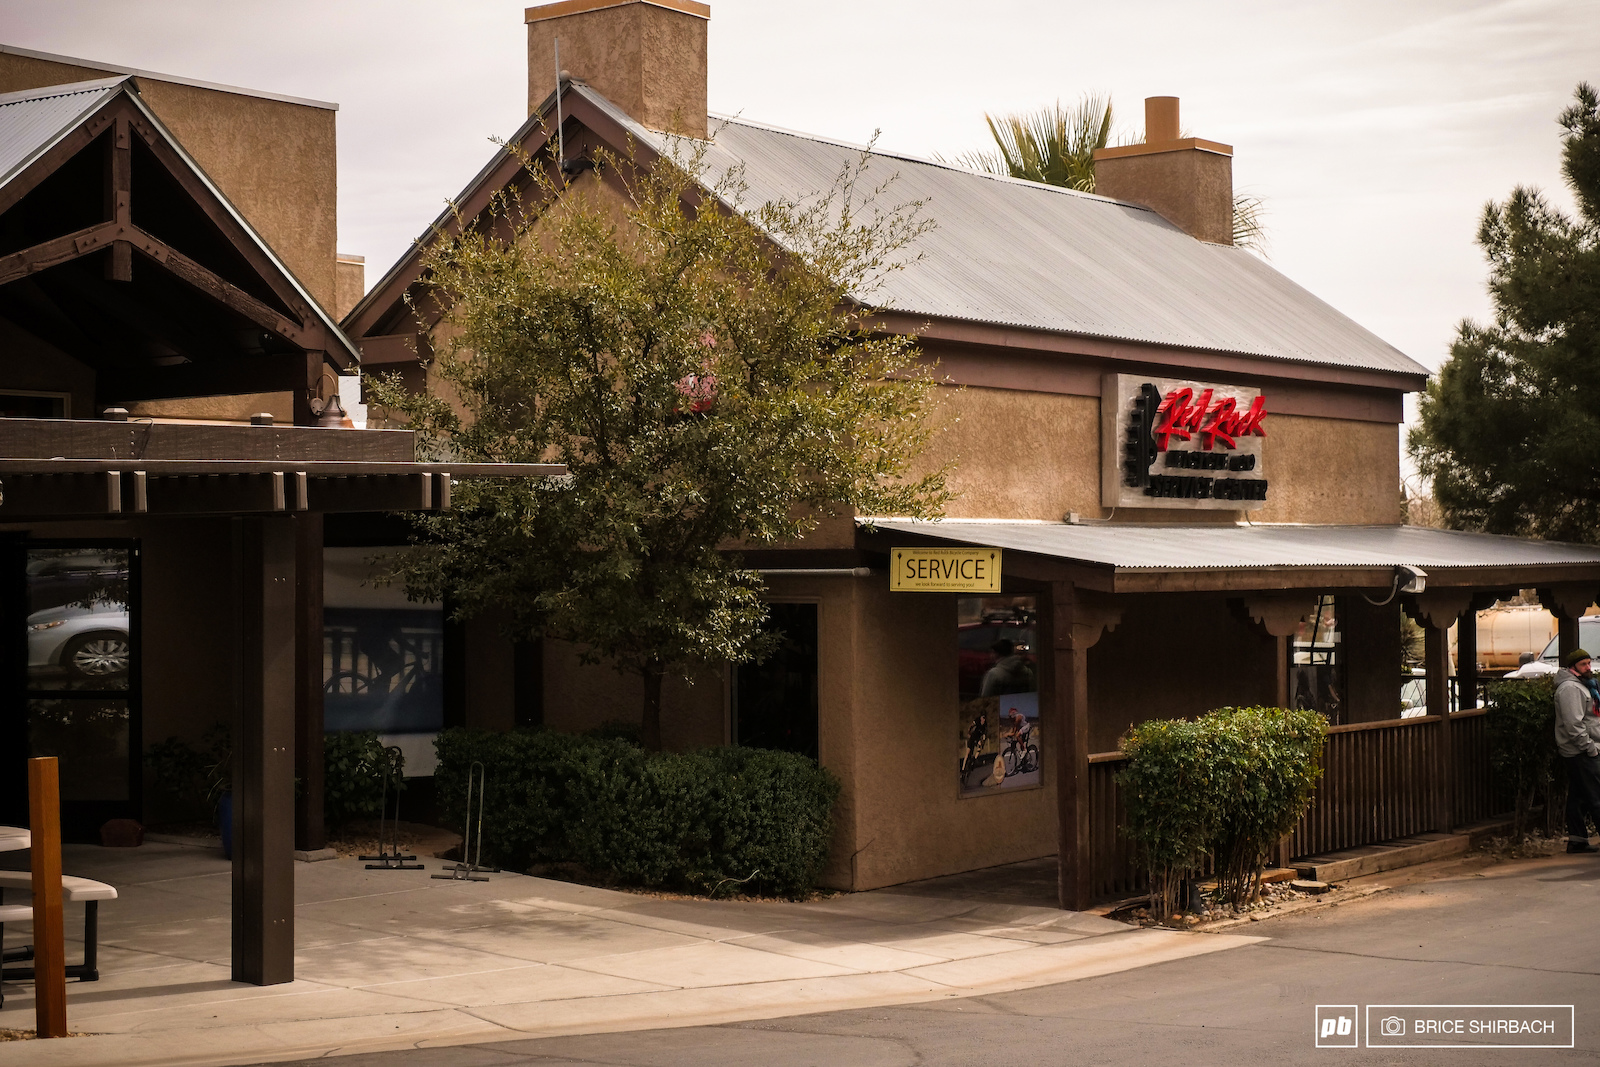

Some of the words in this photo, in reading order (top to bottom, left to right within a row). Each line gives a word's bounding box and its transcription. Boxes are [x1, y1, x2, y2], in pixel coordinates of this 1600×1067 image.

[1154, 387, 1214, 452] Red
[1200, 396, 1268, 451] Rock
[906, 558, 985, 579] SERVICE
